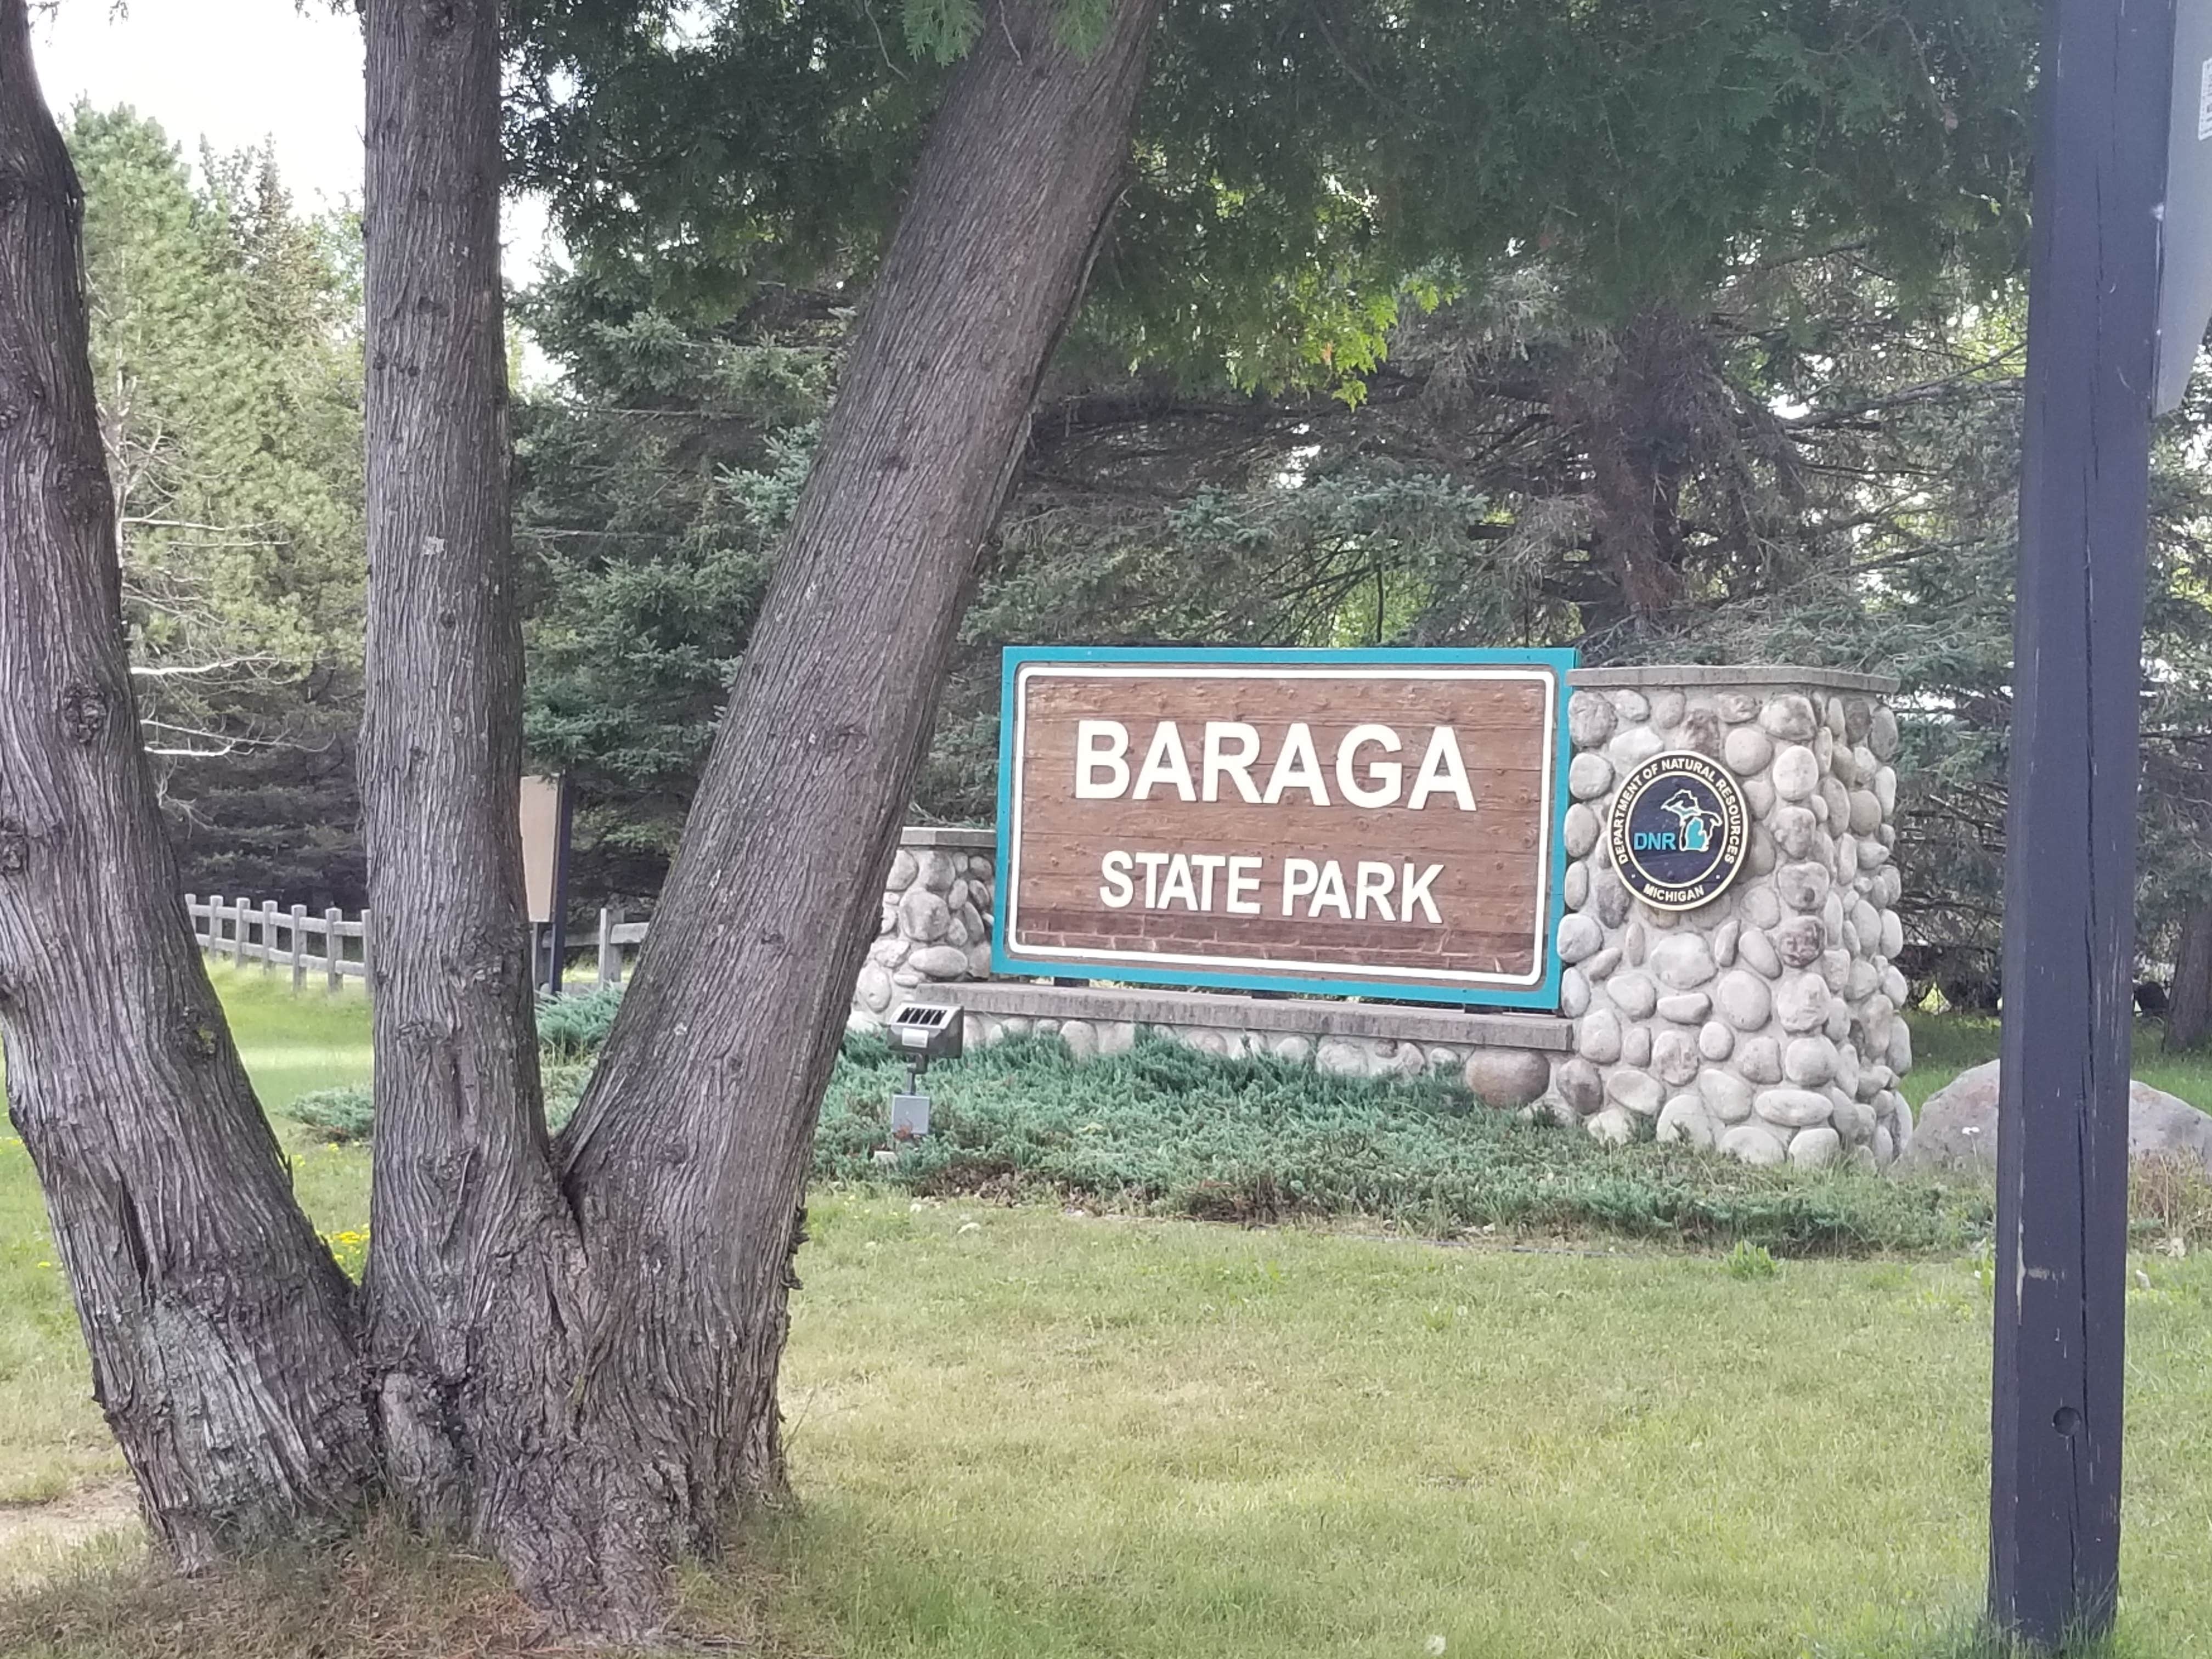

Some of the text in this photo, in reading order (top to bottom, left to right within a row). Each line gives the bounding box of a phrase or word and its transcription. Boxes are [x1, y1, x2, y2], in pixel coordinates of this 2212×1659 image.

[1075, 720, 1477, 812] BARAGA
[1613, 758, 1741, 865] DEPARTMENT OF NATURAL RESOURCES
[1633, 832, 1677, 850] DNR
[1099, 850, 1445, 924] STATE PARK
[1643, 883, 1705, 902] MICHIGAN
